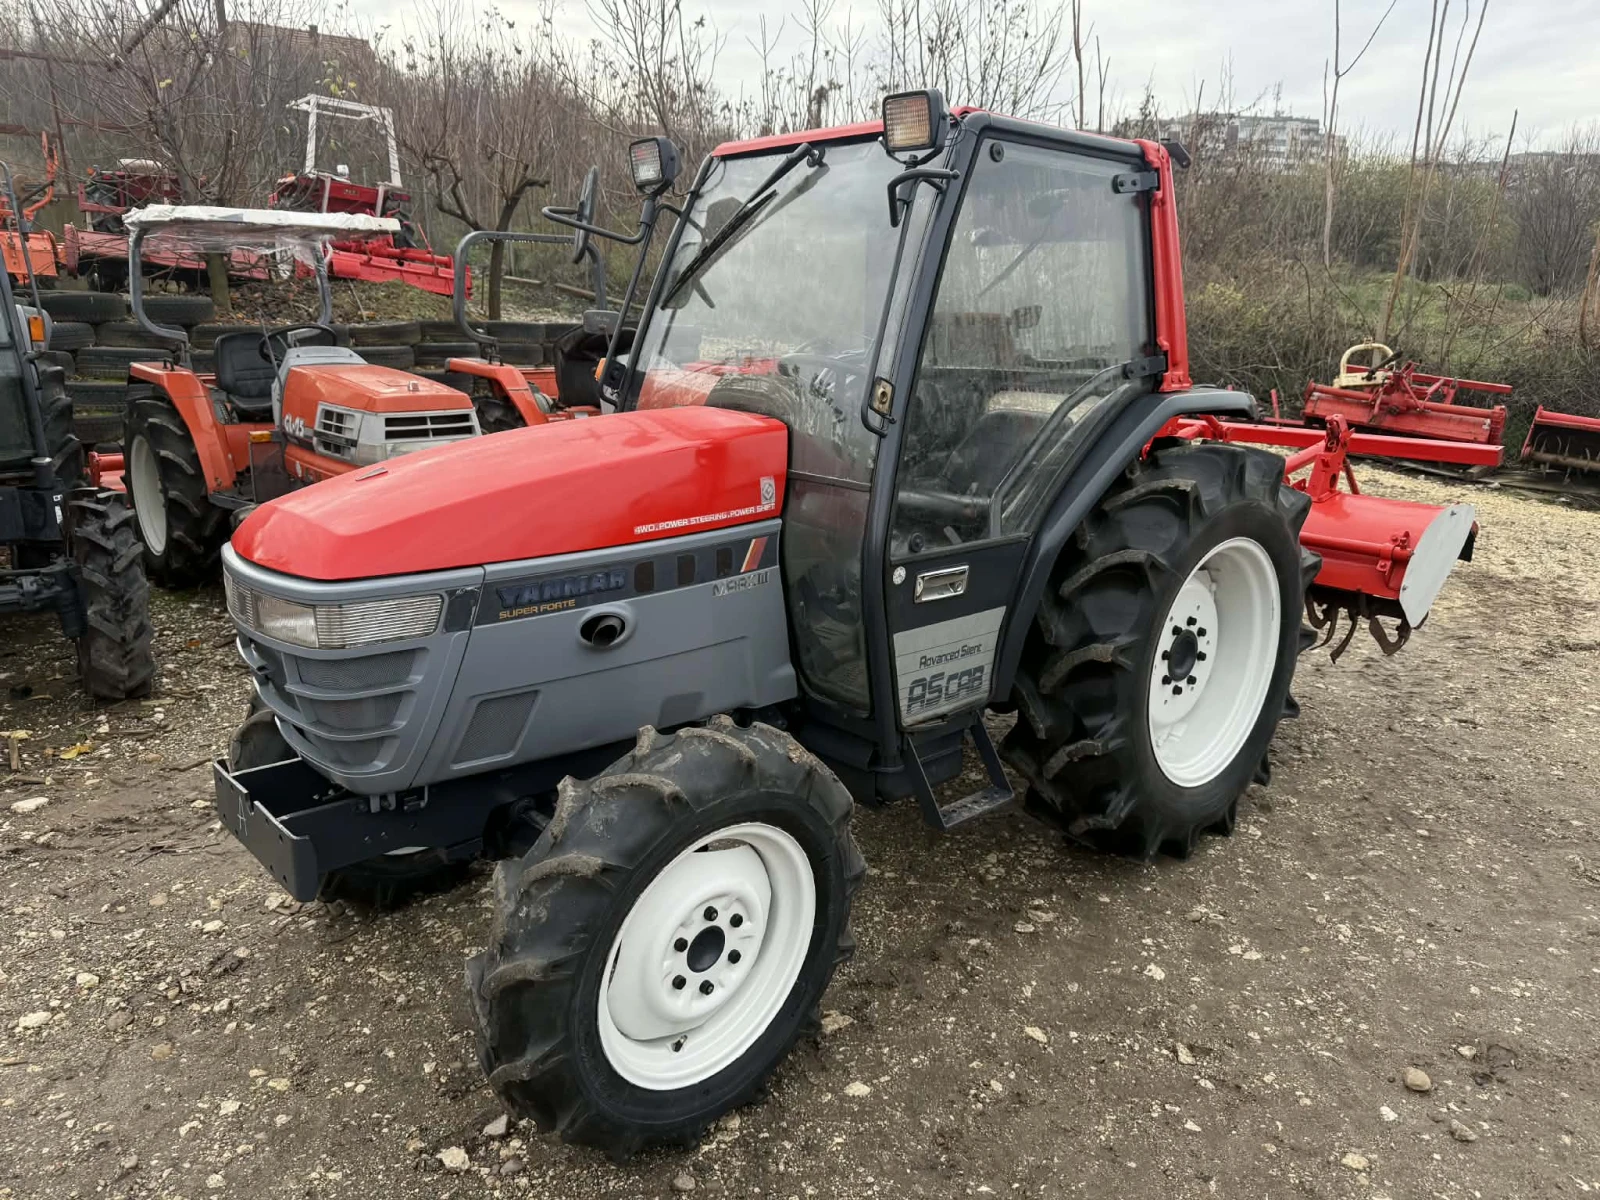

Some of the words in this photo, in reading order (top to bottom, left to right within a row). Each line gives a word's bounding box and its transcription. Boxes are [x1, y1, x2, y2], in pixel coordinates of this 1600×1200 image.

[756, 503, 775, 513] SHIFT
[496, 569, 627, 608] YANMAR
[499, 605, 539, 619] SUPER
[540, 599, 576, 612] FORTE
[919, 650, 960, 669] Advanced
[960, 643, 982, 657] Silent
